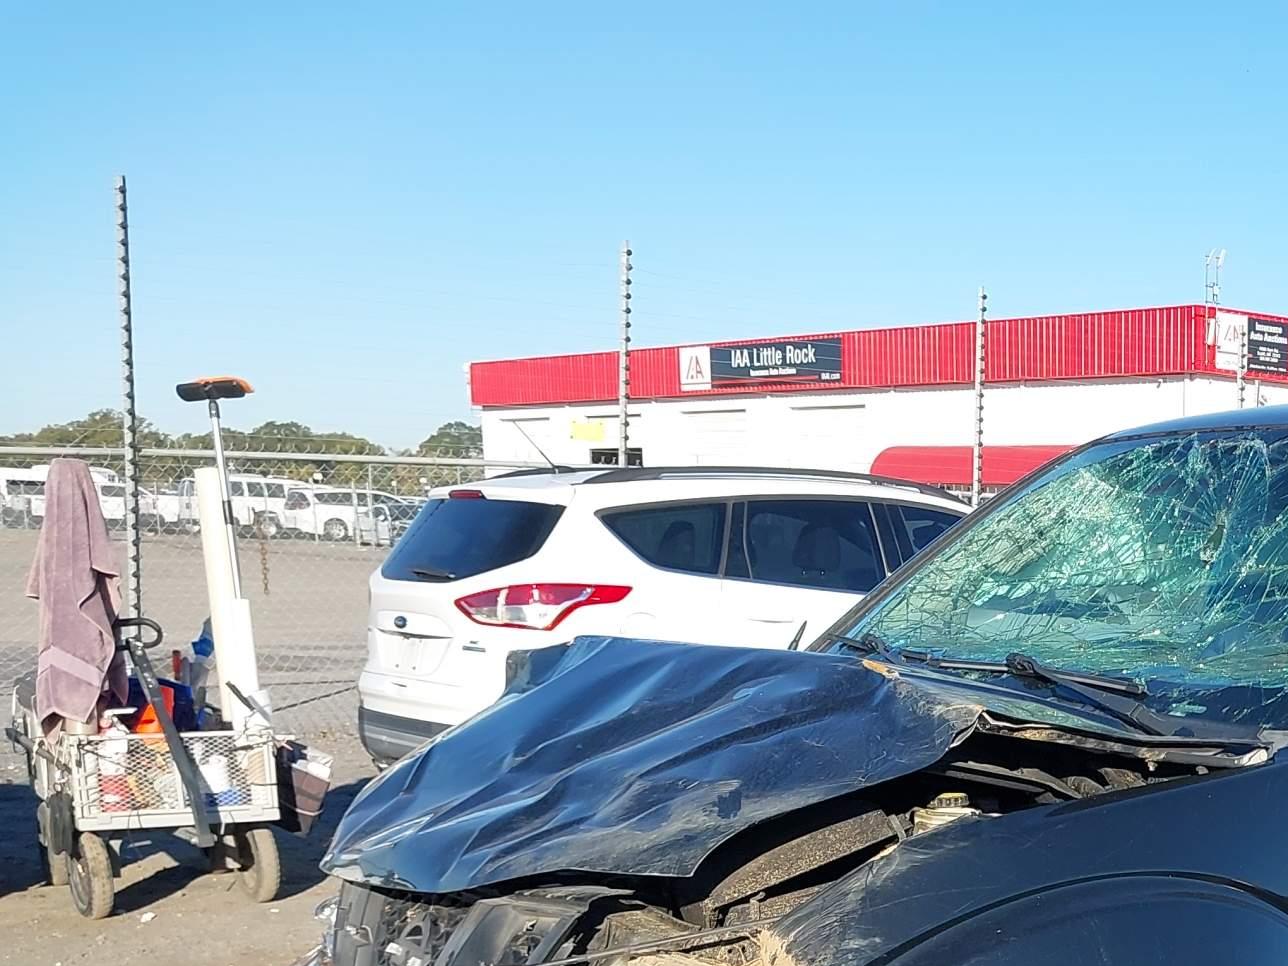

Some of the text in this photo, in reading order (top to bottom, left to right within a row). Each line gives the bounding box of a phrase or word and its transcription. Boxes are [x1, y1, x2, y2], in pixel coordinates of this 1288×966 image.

[731, 343, 816, 368] IAA Little Rock
